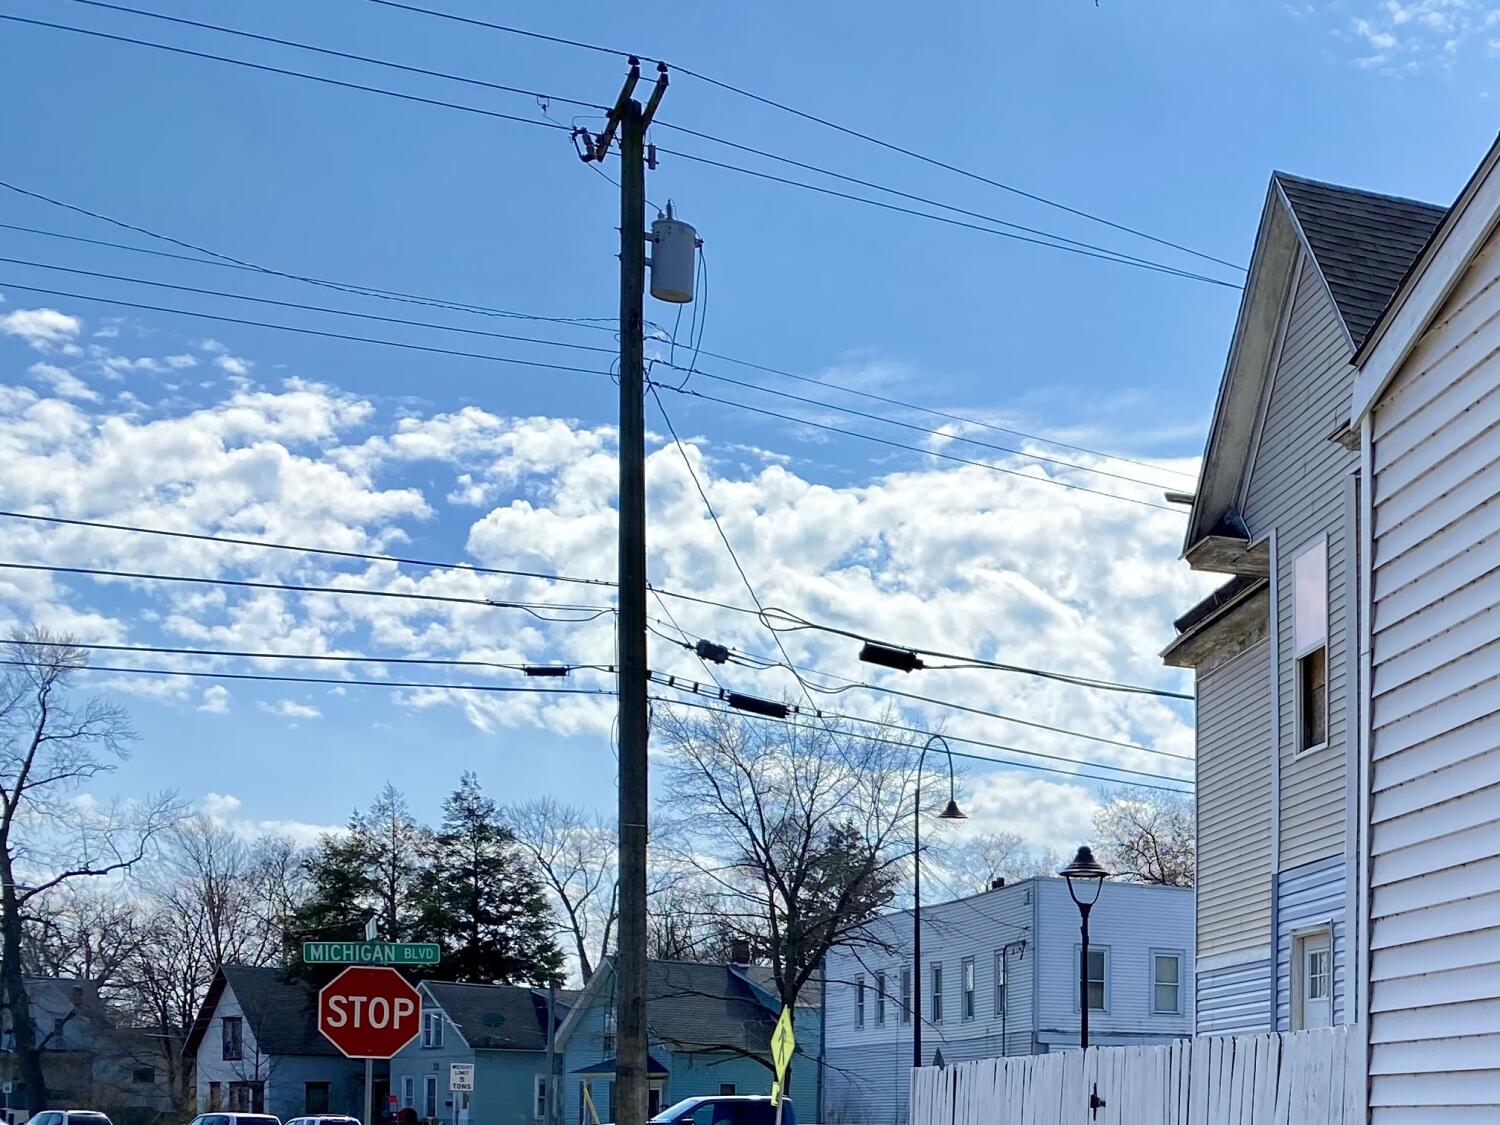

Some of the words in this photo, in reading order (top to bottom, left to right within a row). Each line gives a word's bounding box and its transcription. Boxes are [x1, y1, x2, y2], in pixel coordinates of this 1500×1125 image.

[310, 944, 396, 961] MICHIGAN
[404, 947, 434, 959] BLVD
[326, 995, 415, 1030] STOP
